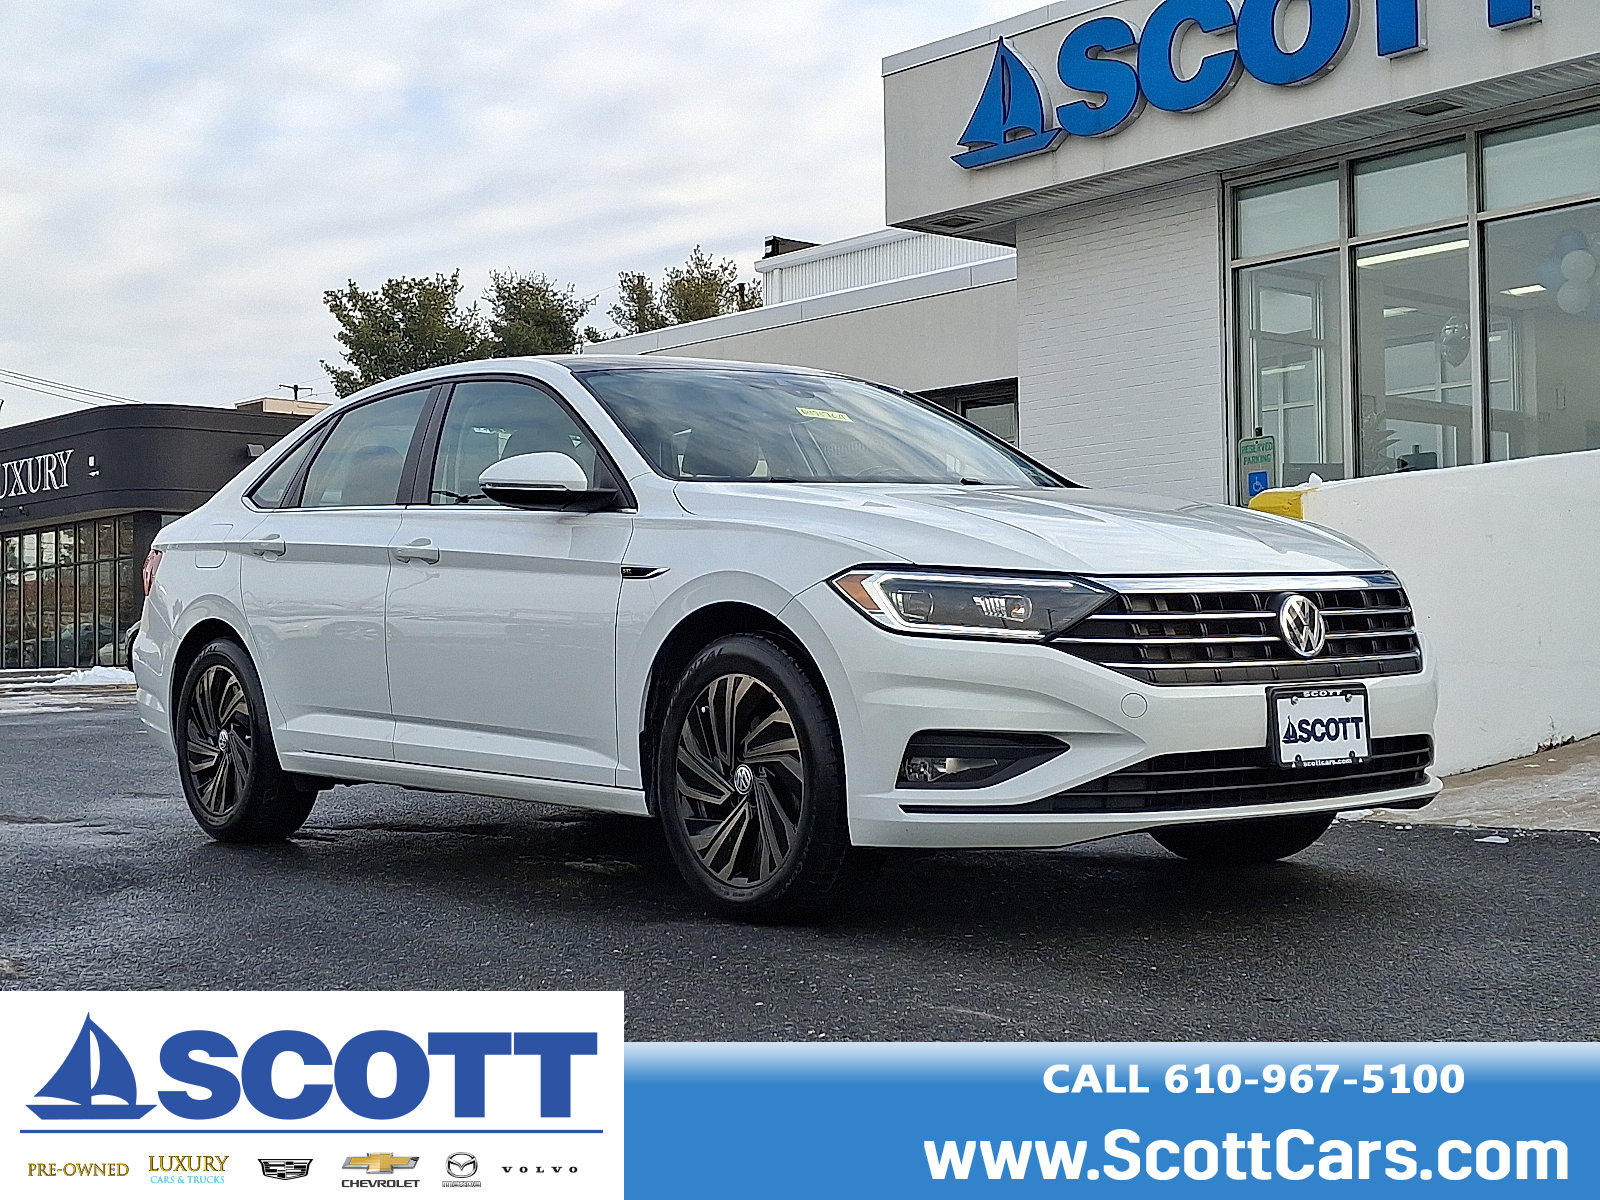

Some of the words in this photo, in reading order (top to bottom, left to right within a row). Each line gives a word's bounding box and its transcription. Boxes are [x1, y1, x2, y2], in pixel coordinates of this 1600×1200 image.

[1056, 0, 1542, 137] SCO
[1241, 442, 1273, 454] RESERVED
[1243, 454, 1271, 465] PARKING
[1302, 690, 1342, 698] SCOTT
[1298, 717, 1363, 743] SCOTT
